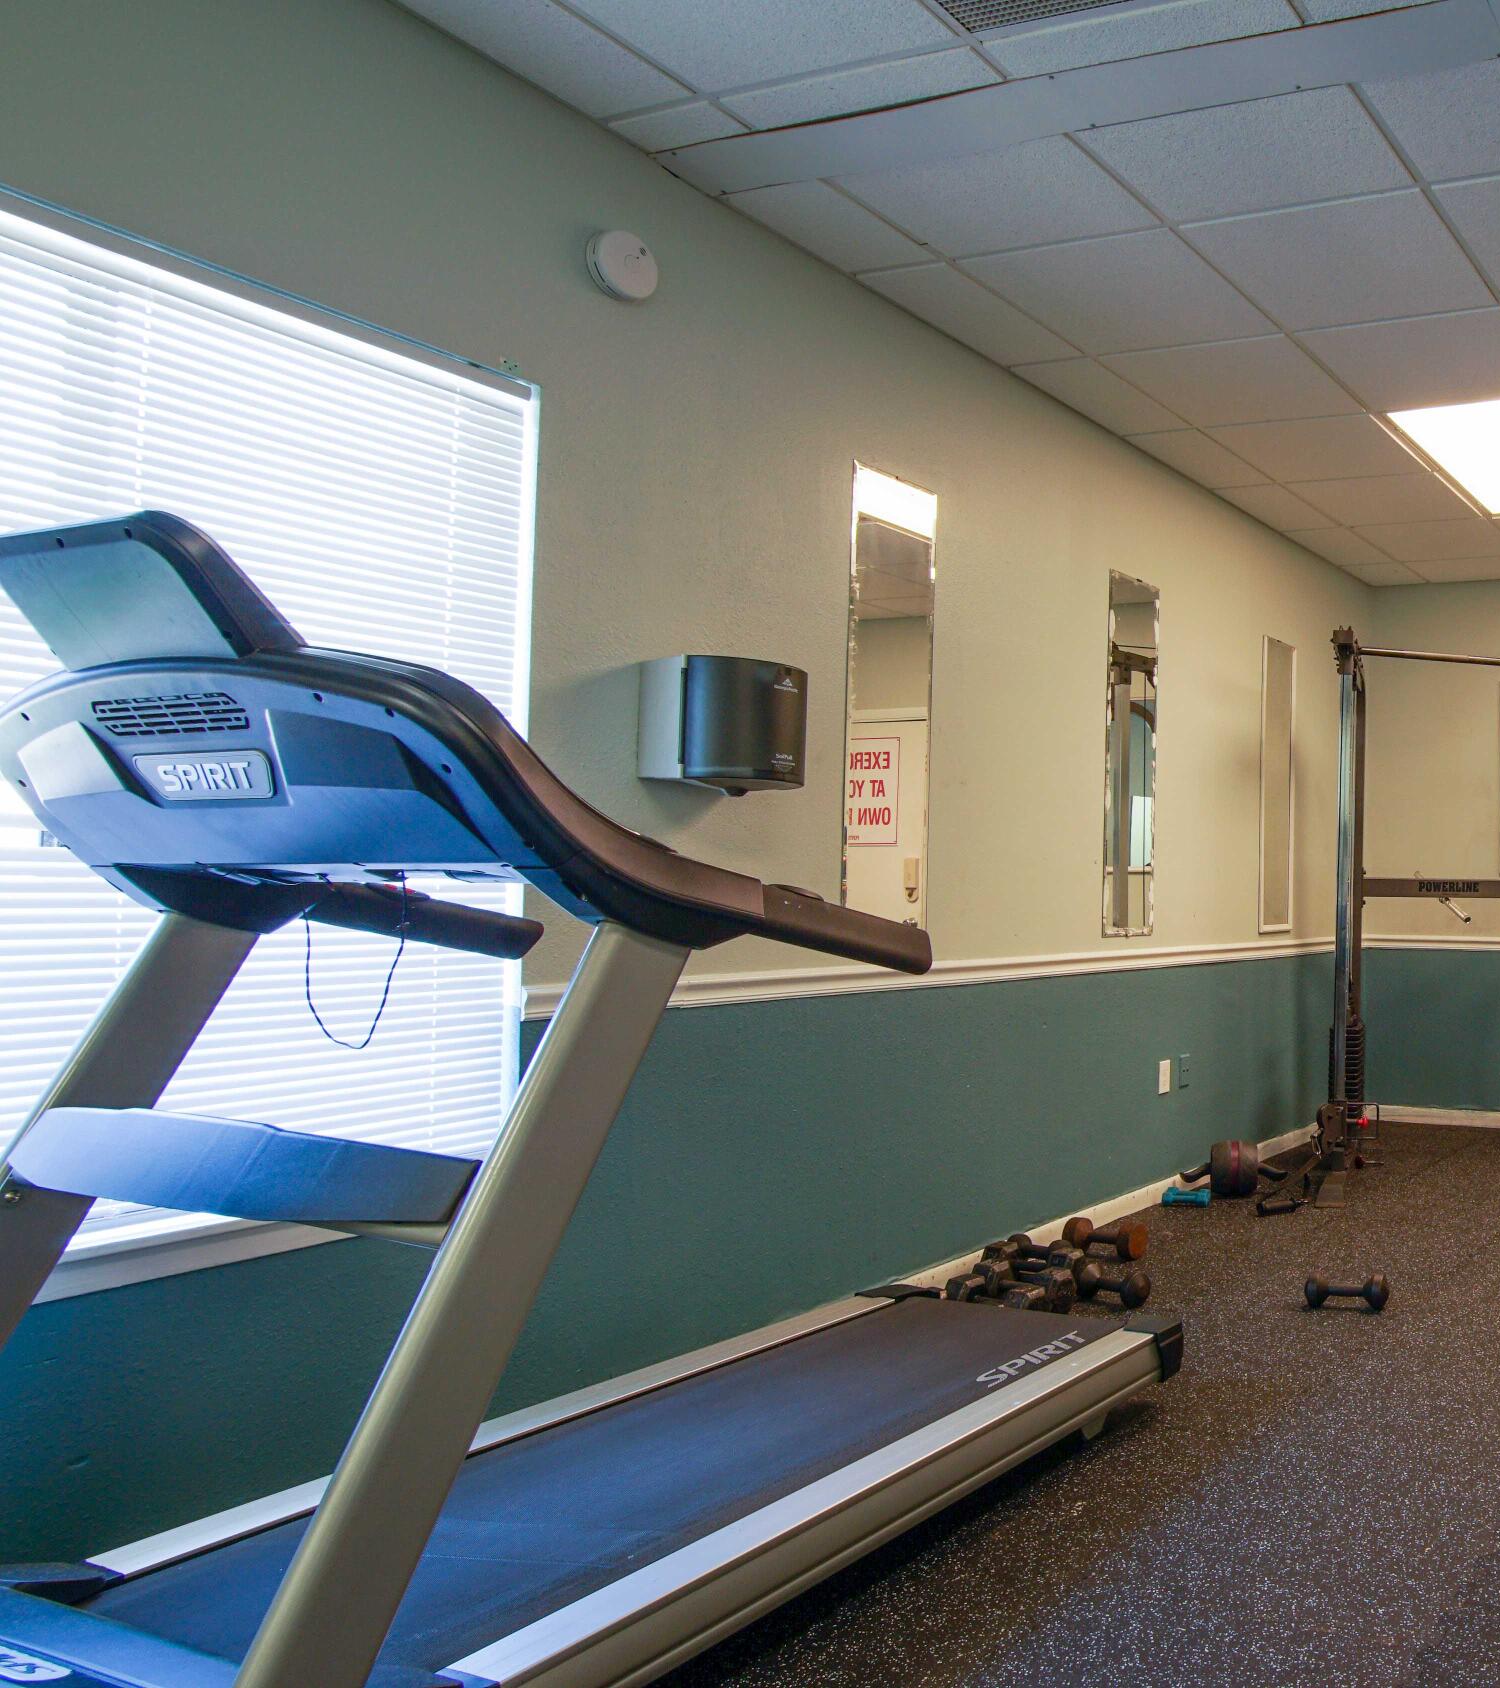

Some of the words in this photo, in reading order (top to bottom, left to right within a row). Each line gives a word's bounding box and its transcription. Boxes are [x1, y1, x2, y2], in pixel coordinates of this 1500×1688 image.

[157, 761, 253, 792] SPIRIT
[1418, 881, 1480, 893] POWERLINE
[976, 1330, 1086, 1388] SPIRIT
